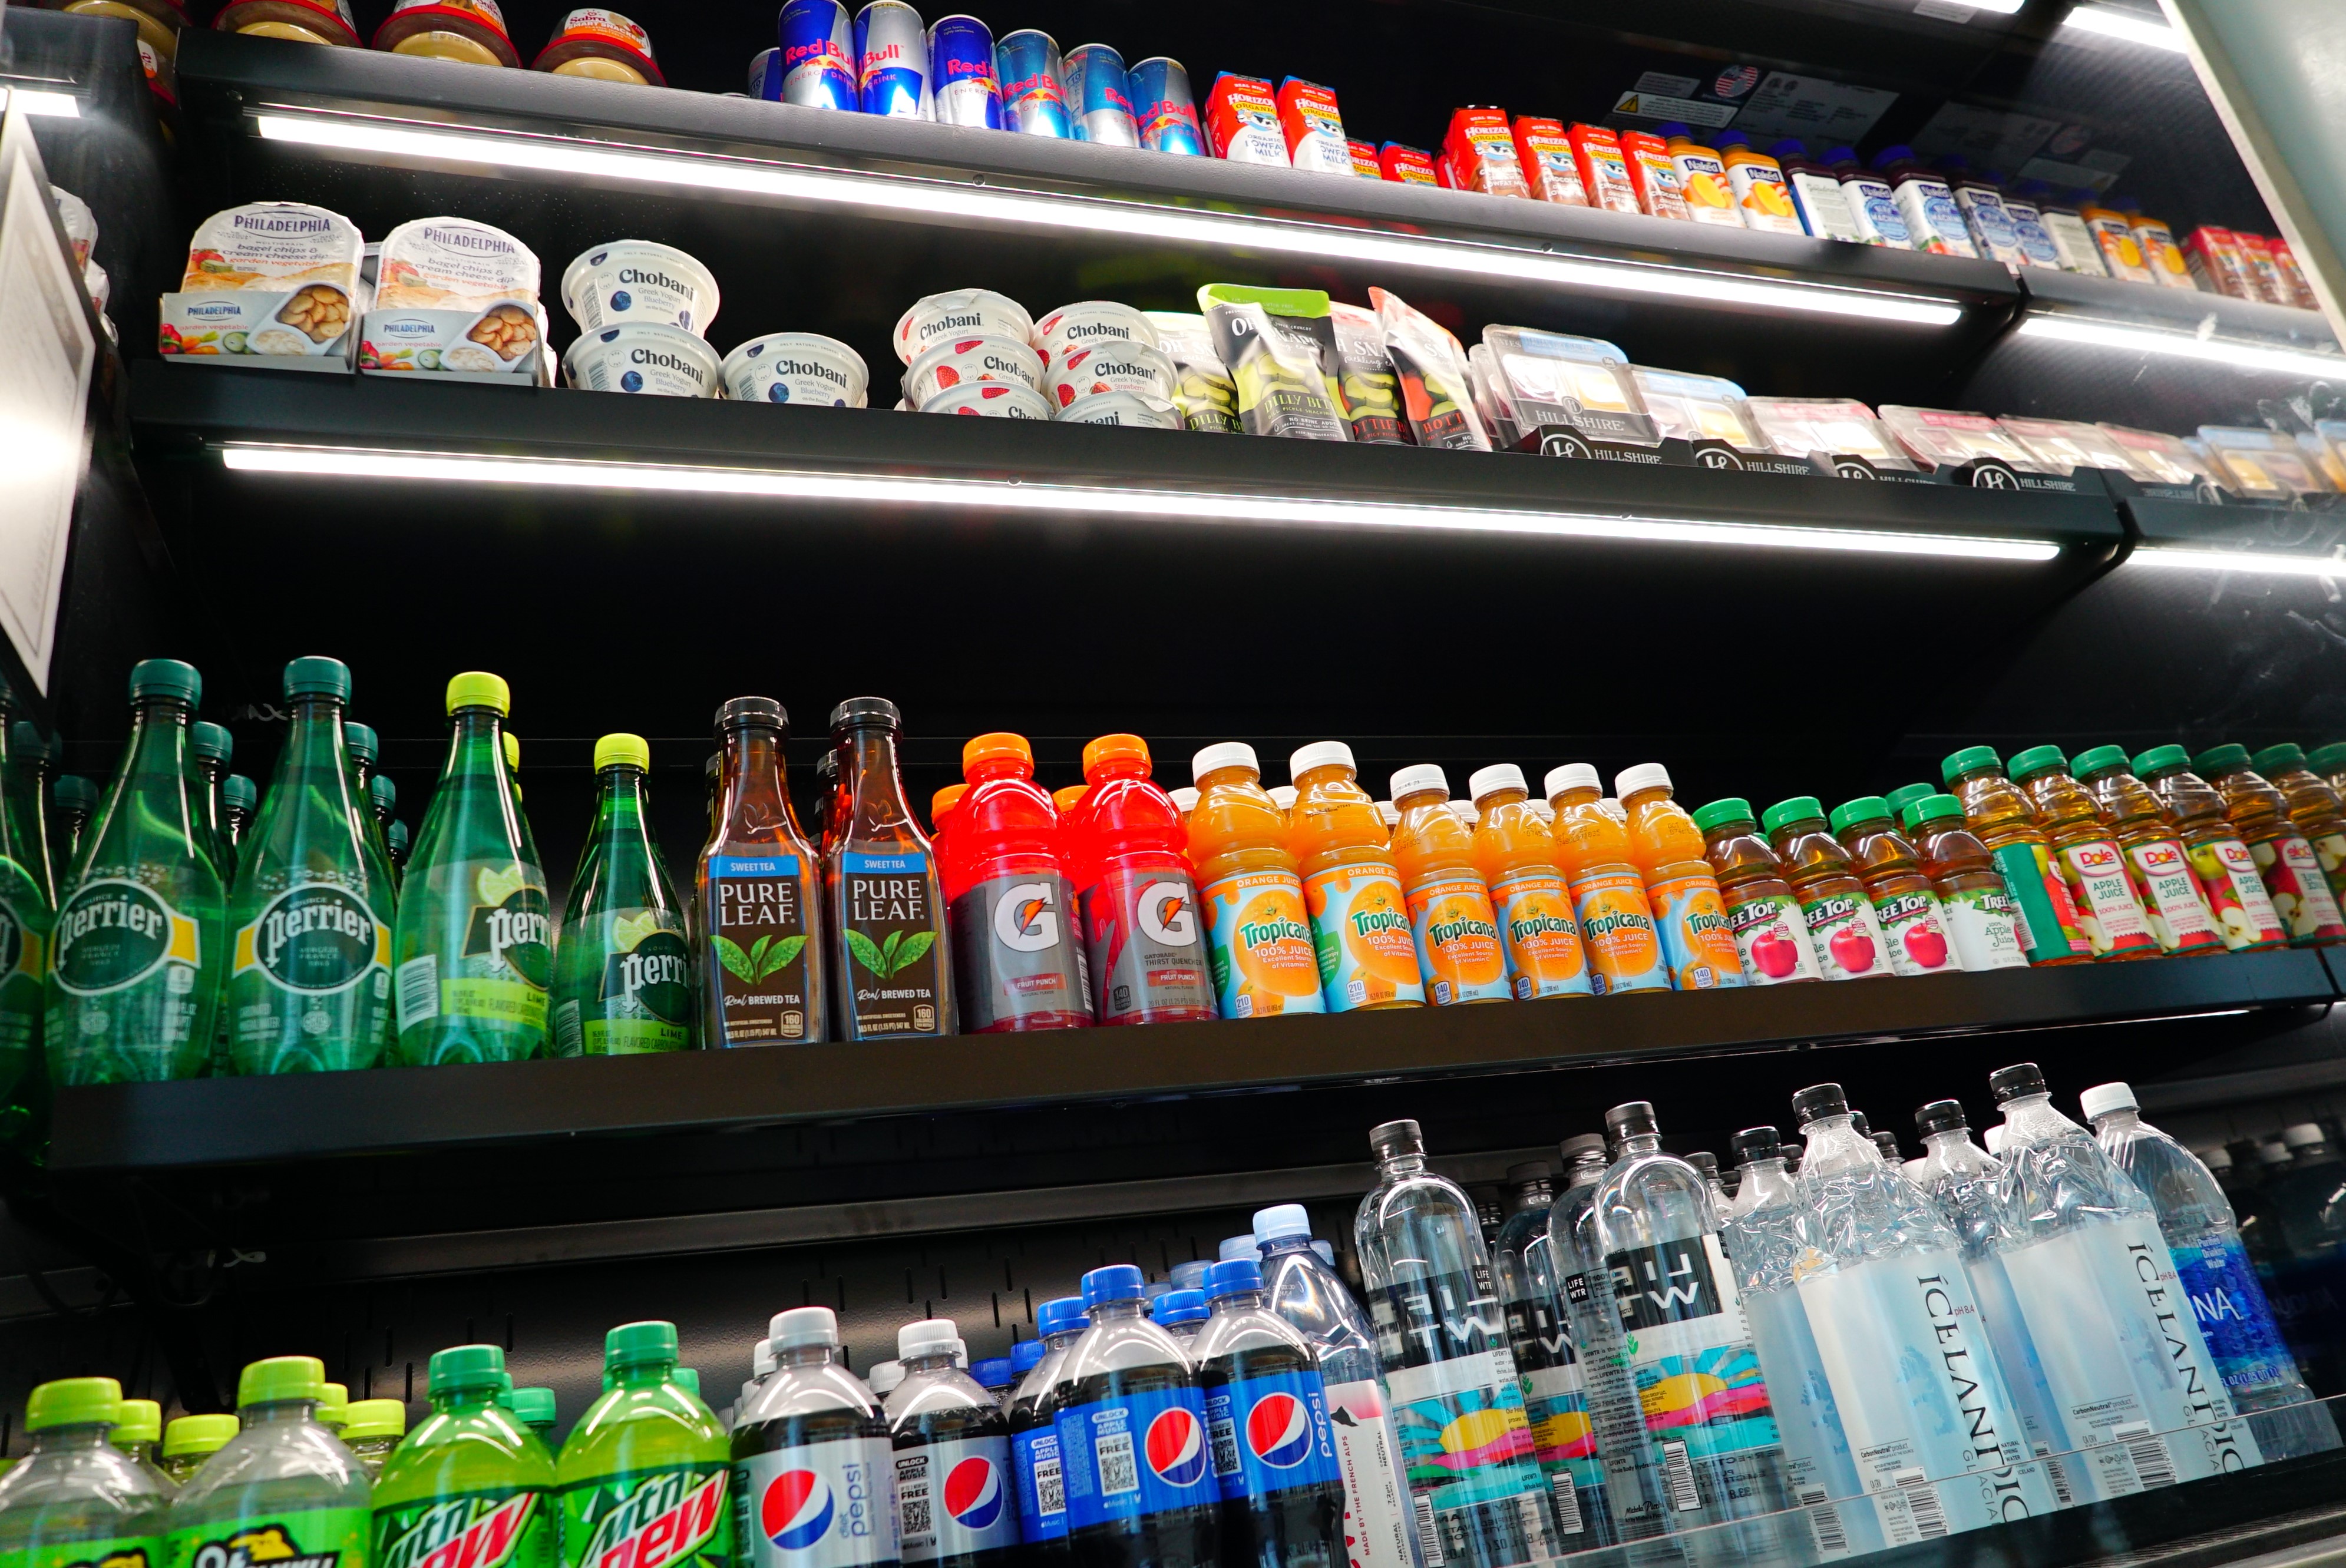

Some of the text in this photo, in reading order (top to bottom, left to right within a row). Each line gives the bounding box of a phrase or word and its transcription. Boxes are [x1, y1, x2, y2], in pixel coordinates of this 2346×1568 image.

[570, 16, 606, 24] Sabra
[786, 38, 823, 65] Red
[863, 44, 899, 68] Bull
[947, 59, 988, 75] Red
[1236, 102, 1275, 114] ORGANIC
[1304, 109, 1340, 121] ORGANIC
[1248, 134, 1281, 143] ORGANIC
[1687, 160, 1717, 172] Naked
[1750, 169, 1779, 181] Naked
[234, 214, 331, 233] PHILADELPHIA
[424, 227, 516, 254] PHILADELPHIA
[223, 250, 263, 259] cream
[237, 244, 270, 253] bagel
[428, 257, 493, 274] bagel chips
[415, 263, 495, 282] cream cheese
[619, 269, 695, 302] Chobani
[638, 287, 659, 296] Greek
[187, 306, 241, 316] PHILADELPHIA
[384, 324, 435, 333] PHILADELPHIA
[920, 313, 982, 340] Chobani
[1067, 323, 1130, 340] Chobani
[631, 349, 703, 386] Chobani
[1344, 355, 1383, 368] pickling
[650, 369, 670, 378] Greek
[776, 359, 847, 389] Chobani
[816, 381, 835, 393] Yogurt
[1114, 383, 1146, 392] Strawberry
[801, 387, 831, 400] Blueberry
[1264, 395, 1303, 413] DILLY
[1535, 410, 1621, 431] HILLSHIRE
[1594, 449, 1661, 464] HILLSHIRE
[1746, 461, 1810, 475] HILLSHIRE
[2079, 848, 2114, 866] Dole
[2145, 848, 2178, 864] Dole
[731, 862, 776, 872] SWEET TEA
[864, 860, 906, 869] SWEET TEA
[1347, 866, 1386, 876] ORANGE
[1237, 876, 1279, 888] ORANGE
[1509, 882, 1542, 892] ORANGE
[1581, 879, 1613, 891] ORANGE
[2093, 878, 2123, 891] APPLE
[2159, 877, 2188, 890] APPLE
[719, 882, 793, 904] PURE
[853, 879, 923, 899] PURE
[1429, 885, 1461, 896] ORANGE
[2098, 888, 2125, 899] JUICE
[2164, 886, 2190, 898] JUICE
[1980, 894, 2008, 911] TREE
[720, 904, 792, 926] LEAF
[854, 901, 922, 921] LEAF
[1137, 881, 1197, 947] G
[1803, 898, 1853, 927] REE TOP
[1876, 896, 1928, 922] REE TOP
[993, 882, 1060, 952] G
[1510, 914, 1577, 944] Tropicana
[1584, 911, 1650, 940] Tropicana
[1984, 926, 2011, 937] Apple
[1240, 917, 1313, 950] Tropicana
[1429, 917, 1496, 947] Tropicana
[1366, 935, 1396, 945] 100%
[1522, 938, 1548, 950] 100%
[1594, 933, 1648, 947] 100% JUICE
[1993, 935, 2015, 947] Juice
[1254, 945, 1313, 958] 100% JUICE
[1442, 943, 1468, 954] 100%
[1601, 944, 1627, 953] Excellent
[1448, 951, 1475, 960] Excellent
[1696, 970, 1709, 978] 140
[620, 953, 689, 1013] perri
[1017, 978, 1056, 989] FRUIT PUNCH
[1349, 983, 1362, 993] 210
[1436, 984, 1448, 993] 140
[1518, 979, 1529, 988] 140
[748, 994, 800, 1005] BREWED TEA
[857, 988, 931, 1001] Real BREWED TEA
[1236, 997, 1249, 1008] 210
[917, 1008, 931, 1018] 160
[785, 1014, 800, 1025] 160
[2205, 1259, 2225, 1269] Water
[1475, 1270, 1490, 1279] LIFE
[1478, 1281, 1492, 1291] WTR
[1567, 1278, 1584, 1289] LIFE
[1569, 1288, 1586, 1299] WTR
[1964, 1304, 1975, 1315] 8.4
[1583, 1348, 1600, 1358] LIFEWTR
[2073, 1398, 2132, 1415] CarbonNeutral product
[1095, 1410, 1124, 1421] UNLOCK
[1308, 1392, 1333, 1458] pepsi
[1100, 1442, 1130, 1455] FREE
[1891, 1443, 1908, 1453] product
[898, 1457, 925, 1468] UNLOCK
[900, 1472, 927, 1481] MUSIC
[1037, 1467, 1060, 1479] FREE
[842, 1463, 869, 1537] pepsi
[901, 1488, 929, 1500] FREE
[1341, 1435, 1370, 1556] MADE BY THE FRENCH ALPS
[1392, 1522, 1404, 1561] NATURAL
